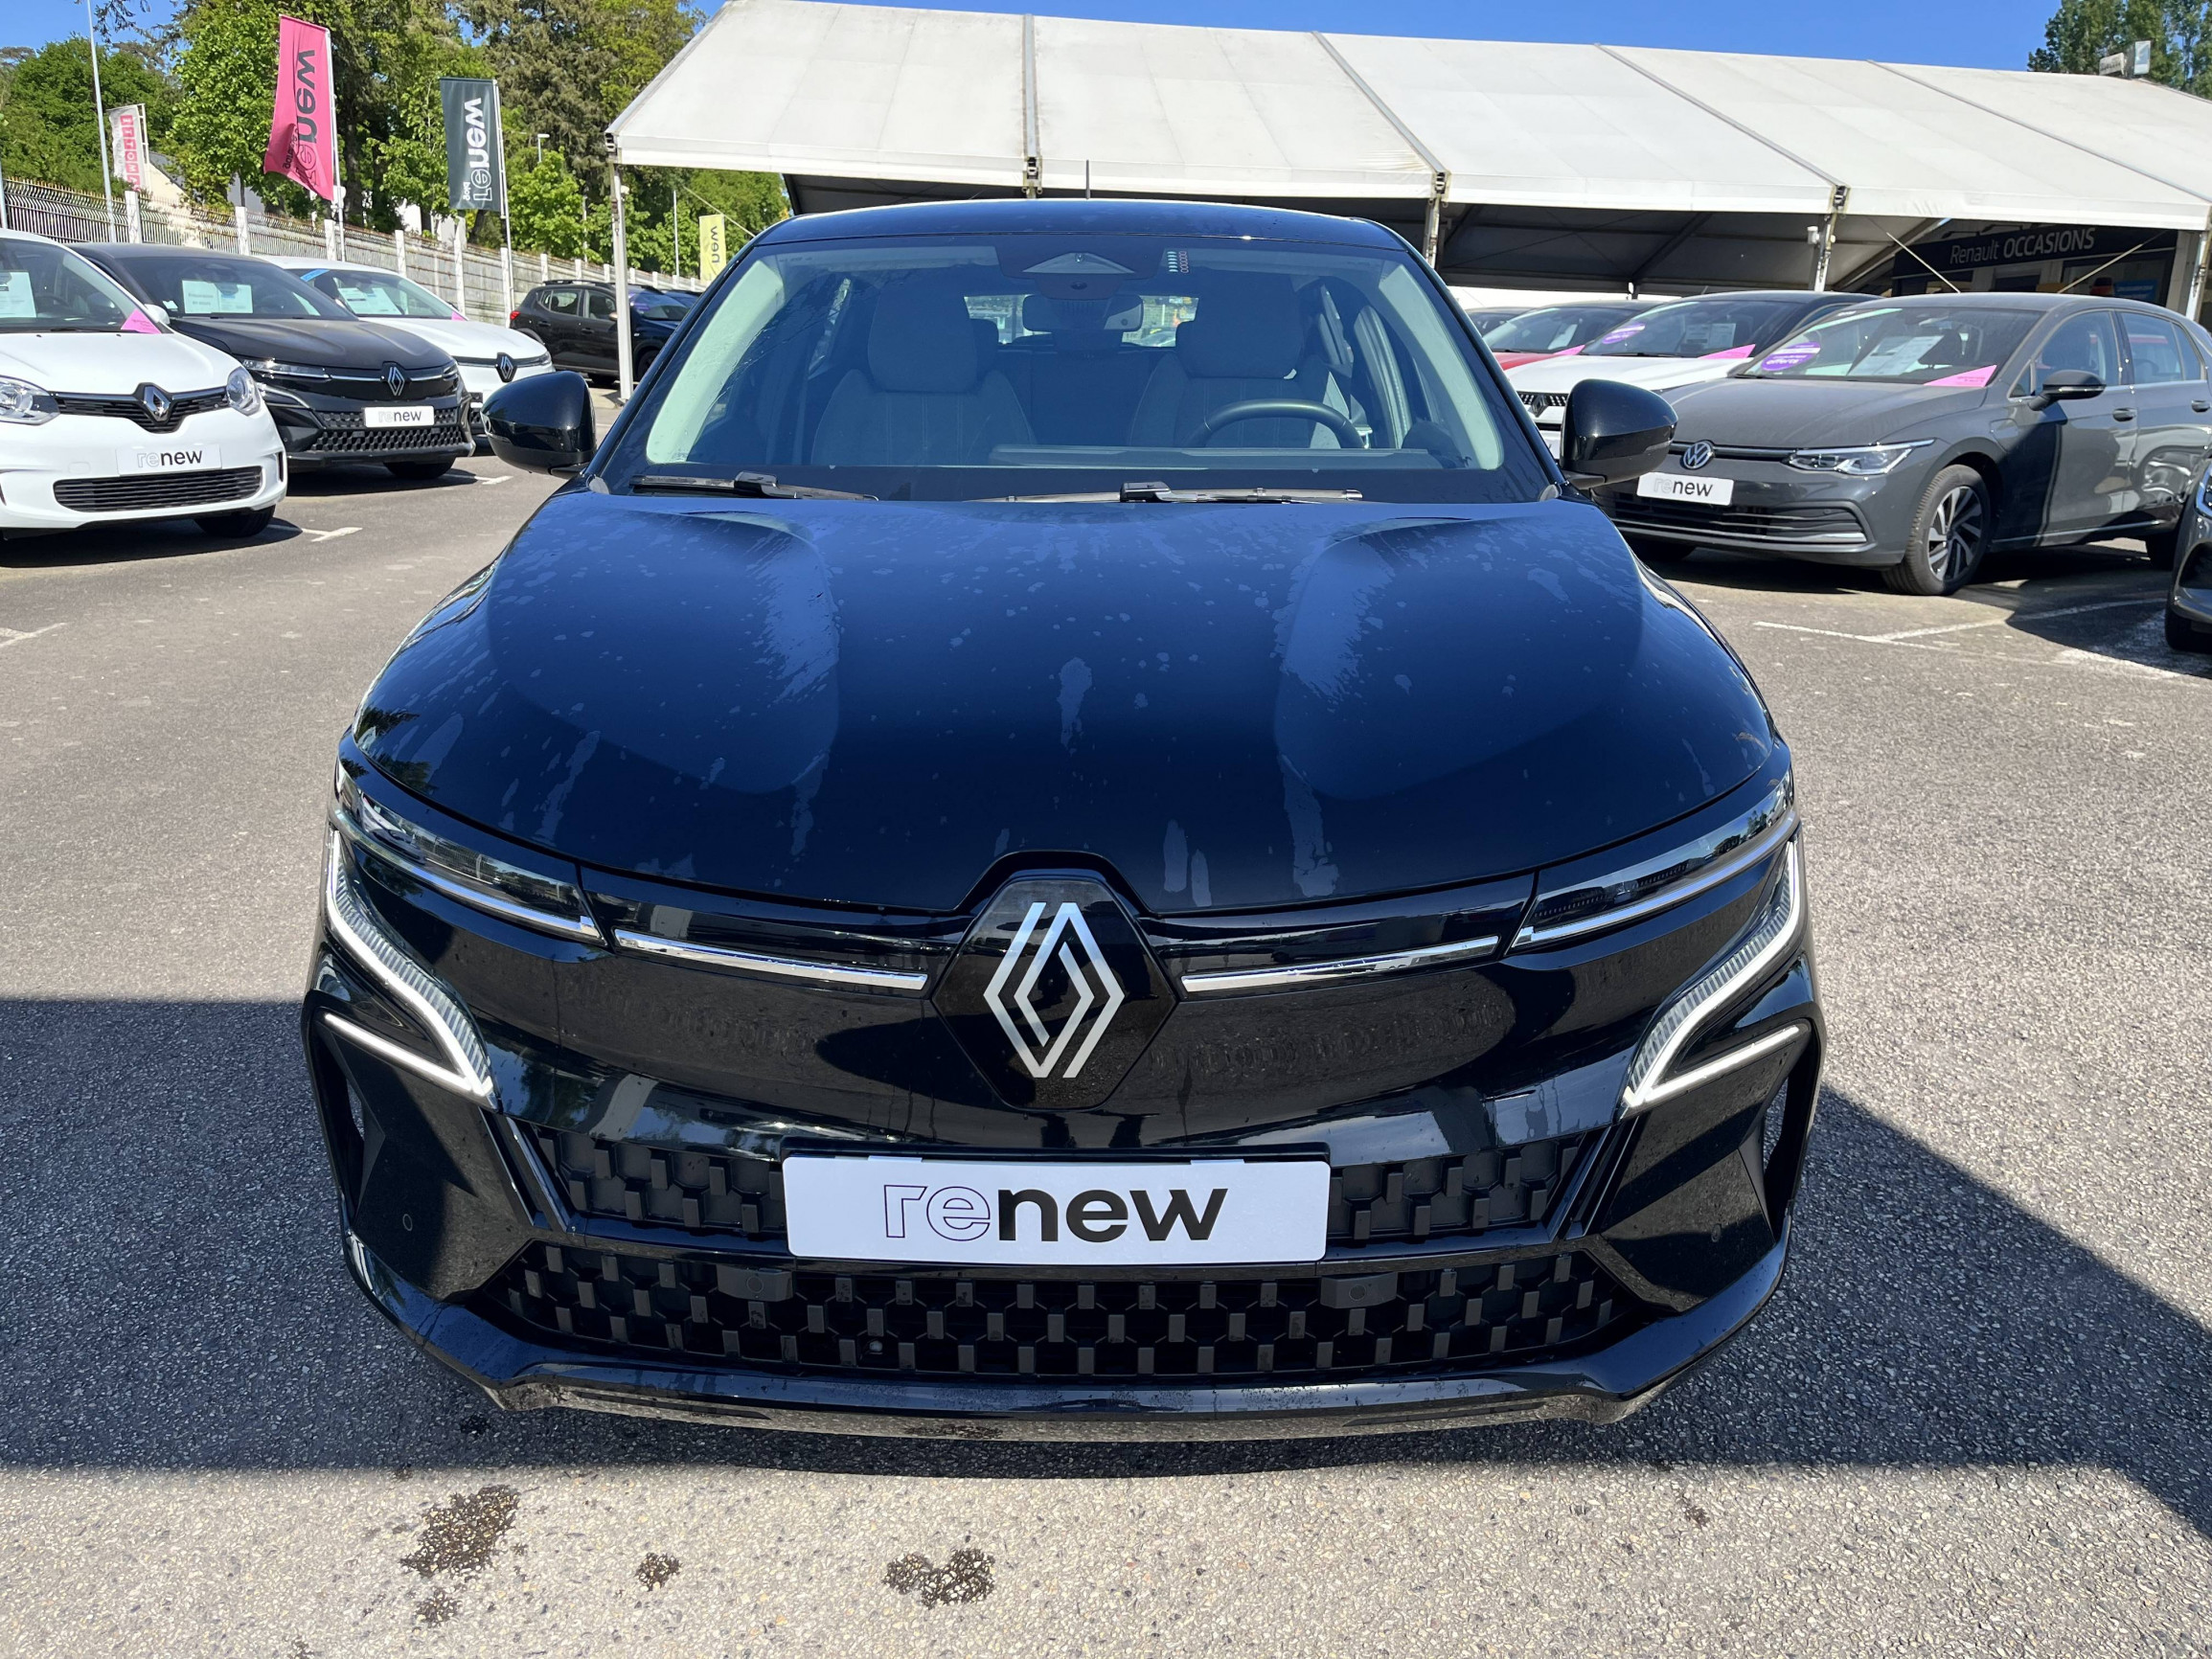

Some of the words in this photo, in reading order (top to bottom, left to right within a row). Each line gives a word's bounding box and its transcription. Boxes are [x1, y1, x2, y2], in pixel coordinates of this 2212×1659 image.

[1950, 241, 2000, 264] Renault
[2003, 227, 2096, 259] OCCASIONS
[377, 410, 422, 423] renew
[136, 450, 203, 468] renew
[1653, 478, 1714, 497] renew
[883, 1184, 1229, 1243] renew
